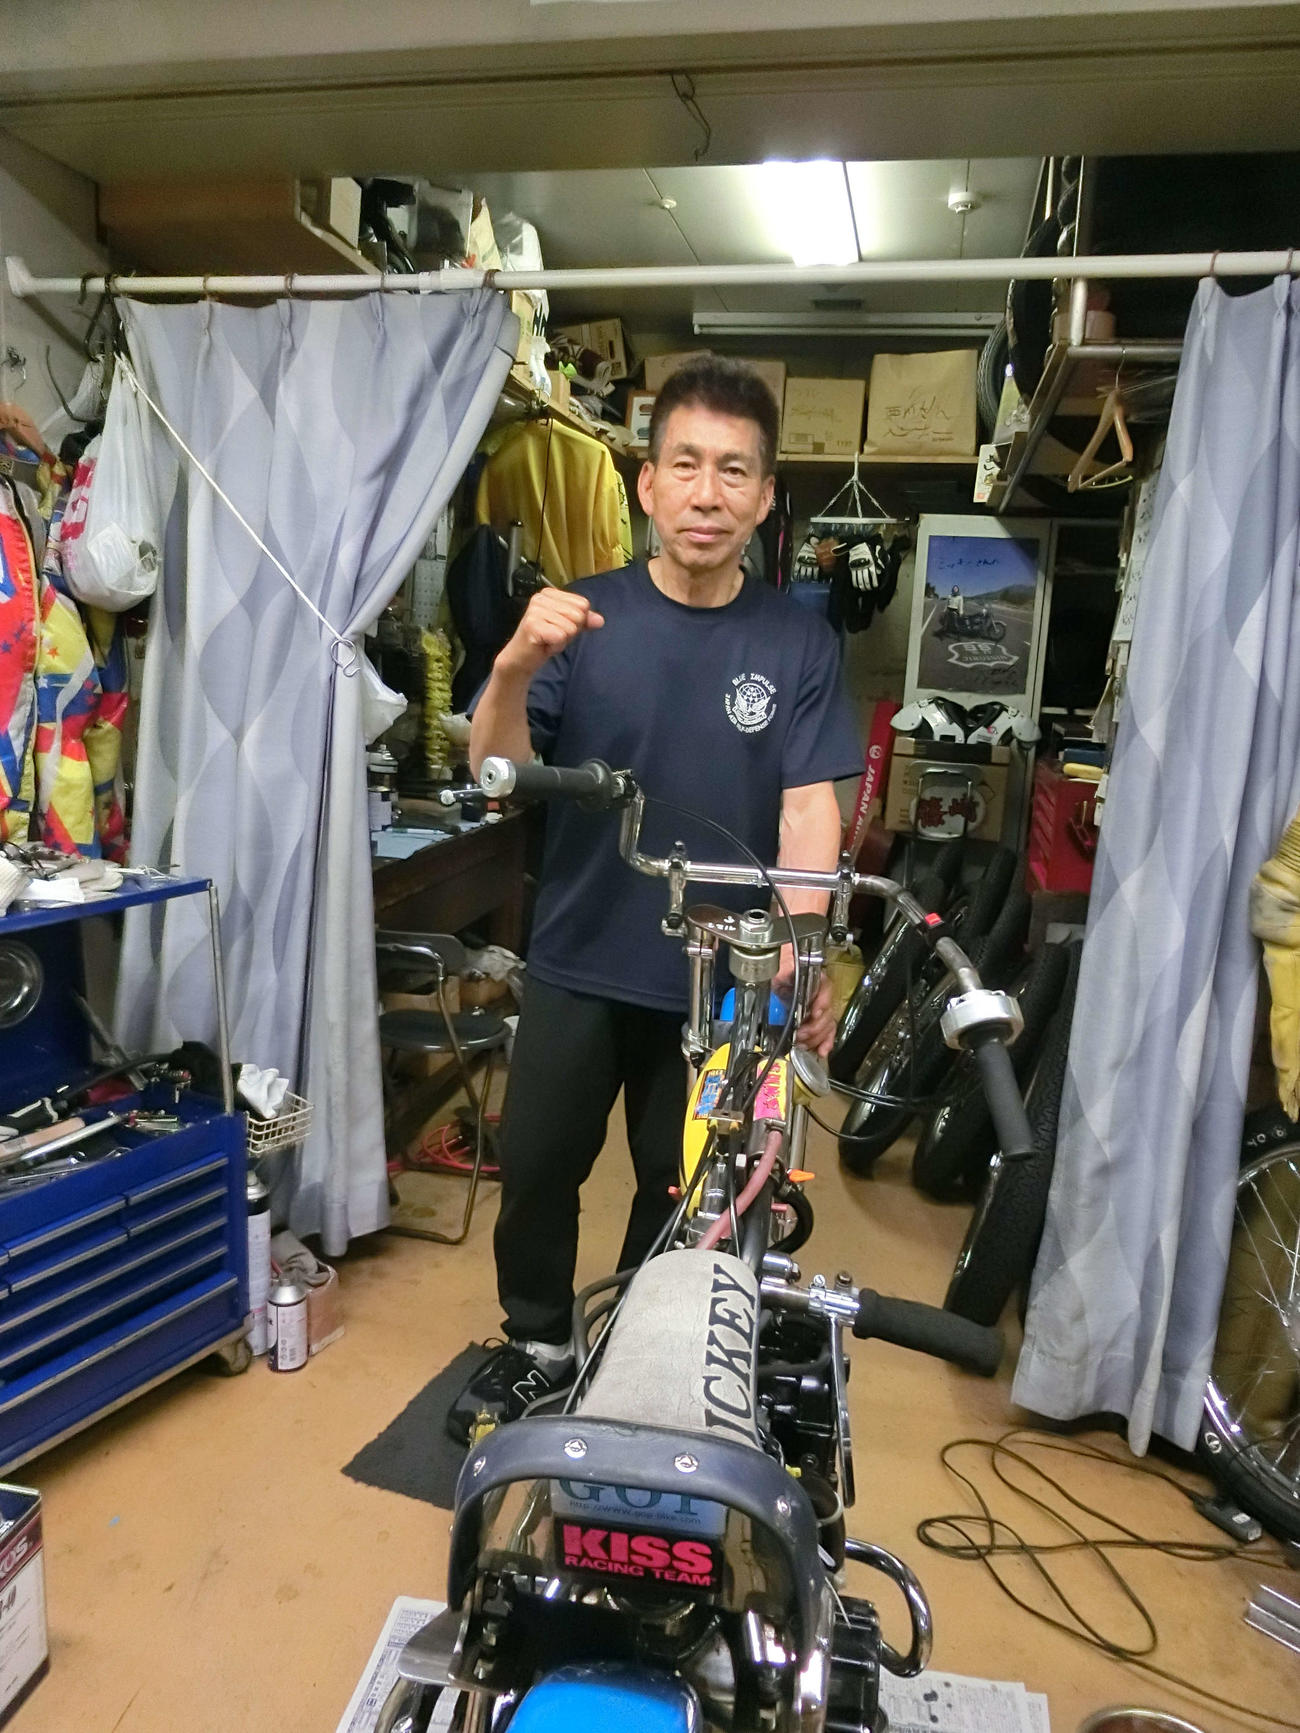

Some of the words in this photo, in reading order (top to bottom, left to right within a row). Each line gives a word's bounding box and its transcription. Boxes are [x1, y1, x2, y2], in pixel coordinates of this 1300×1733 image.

[750, 673, 777, 694] IMPULSE
[860, 764, 875, 814] JAPAN
[563, 1524, 713, 1575] KISS
[564, 1555, 645, 1577] RACING
[651, 1568, 712, 1587] TEAM
